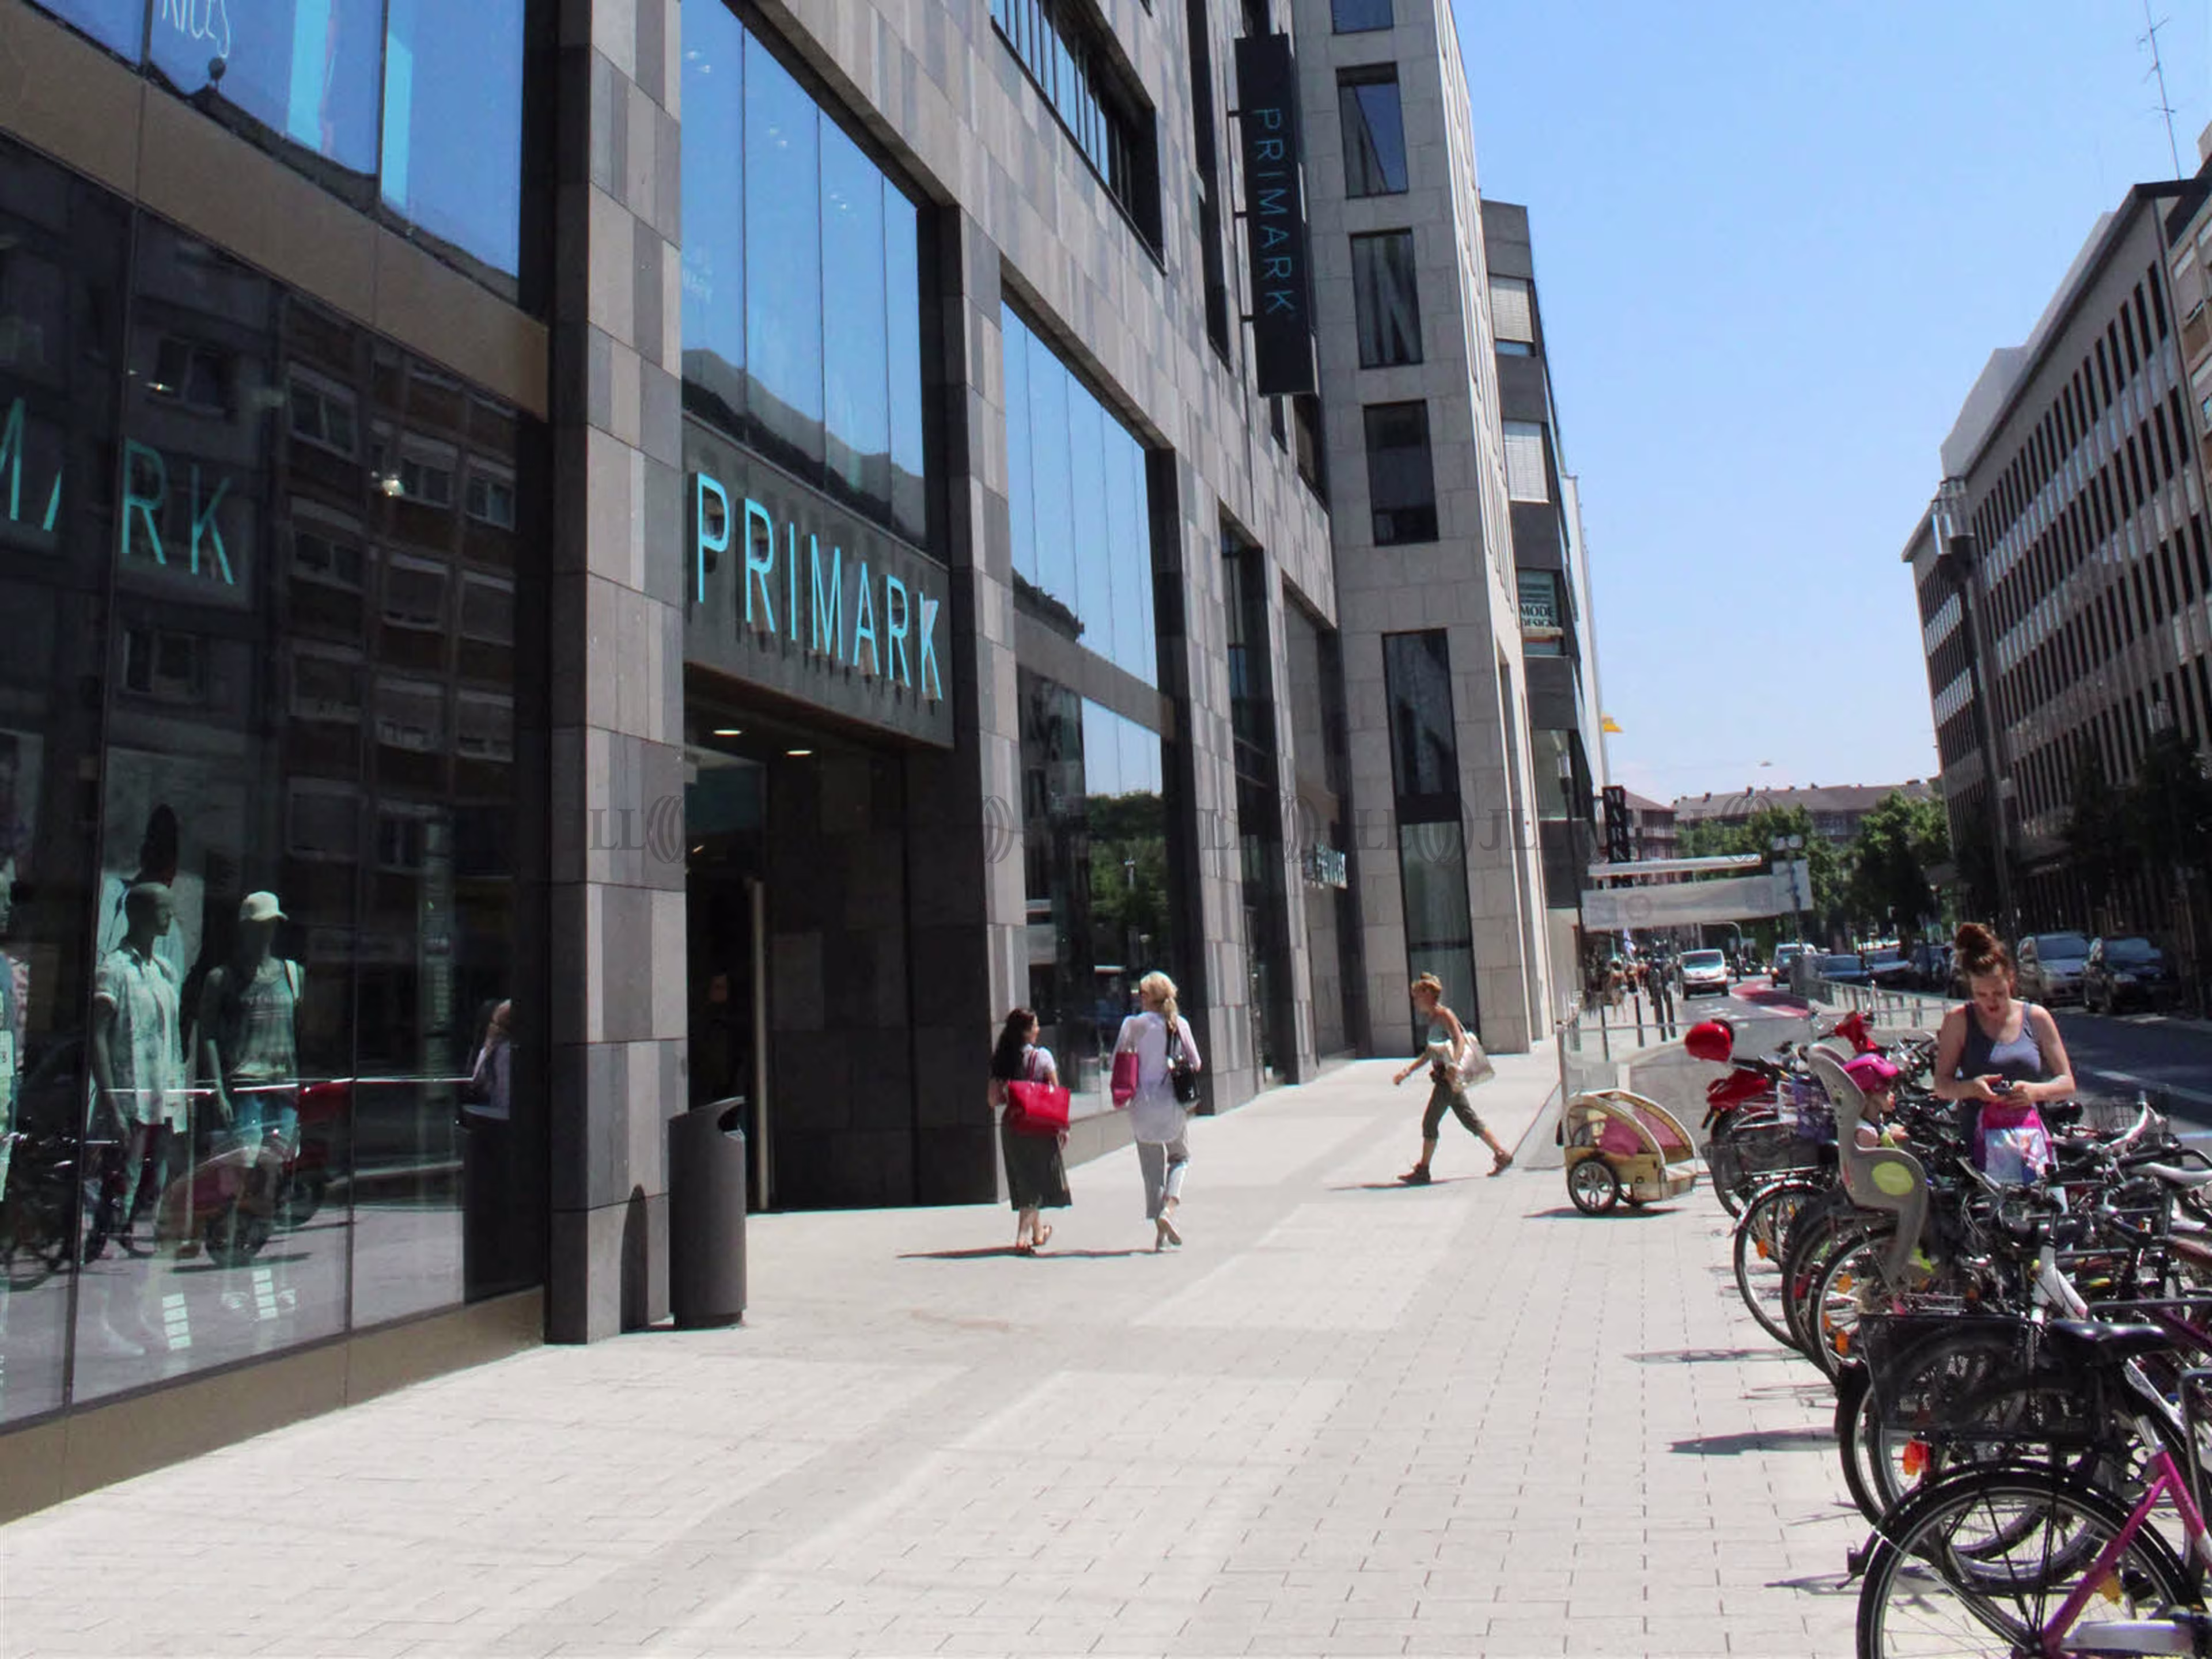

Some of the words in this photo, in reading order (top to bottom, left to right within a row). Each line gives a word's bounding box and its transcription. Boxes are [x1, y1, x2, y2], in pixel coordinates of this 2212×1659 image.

[1252, 108, 1296, 314] PRIMARK
[697, 472, 942, 701] PRIMARK
[1520, 604, 1554, 616] MODE
